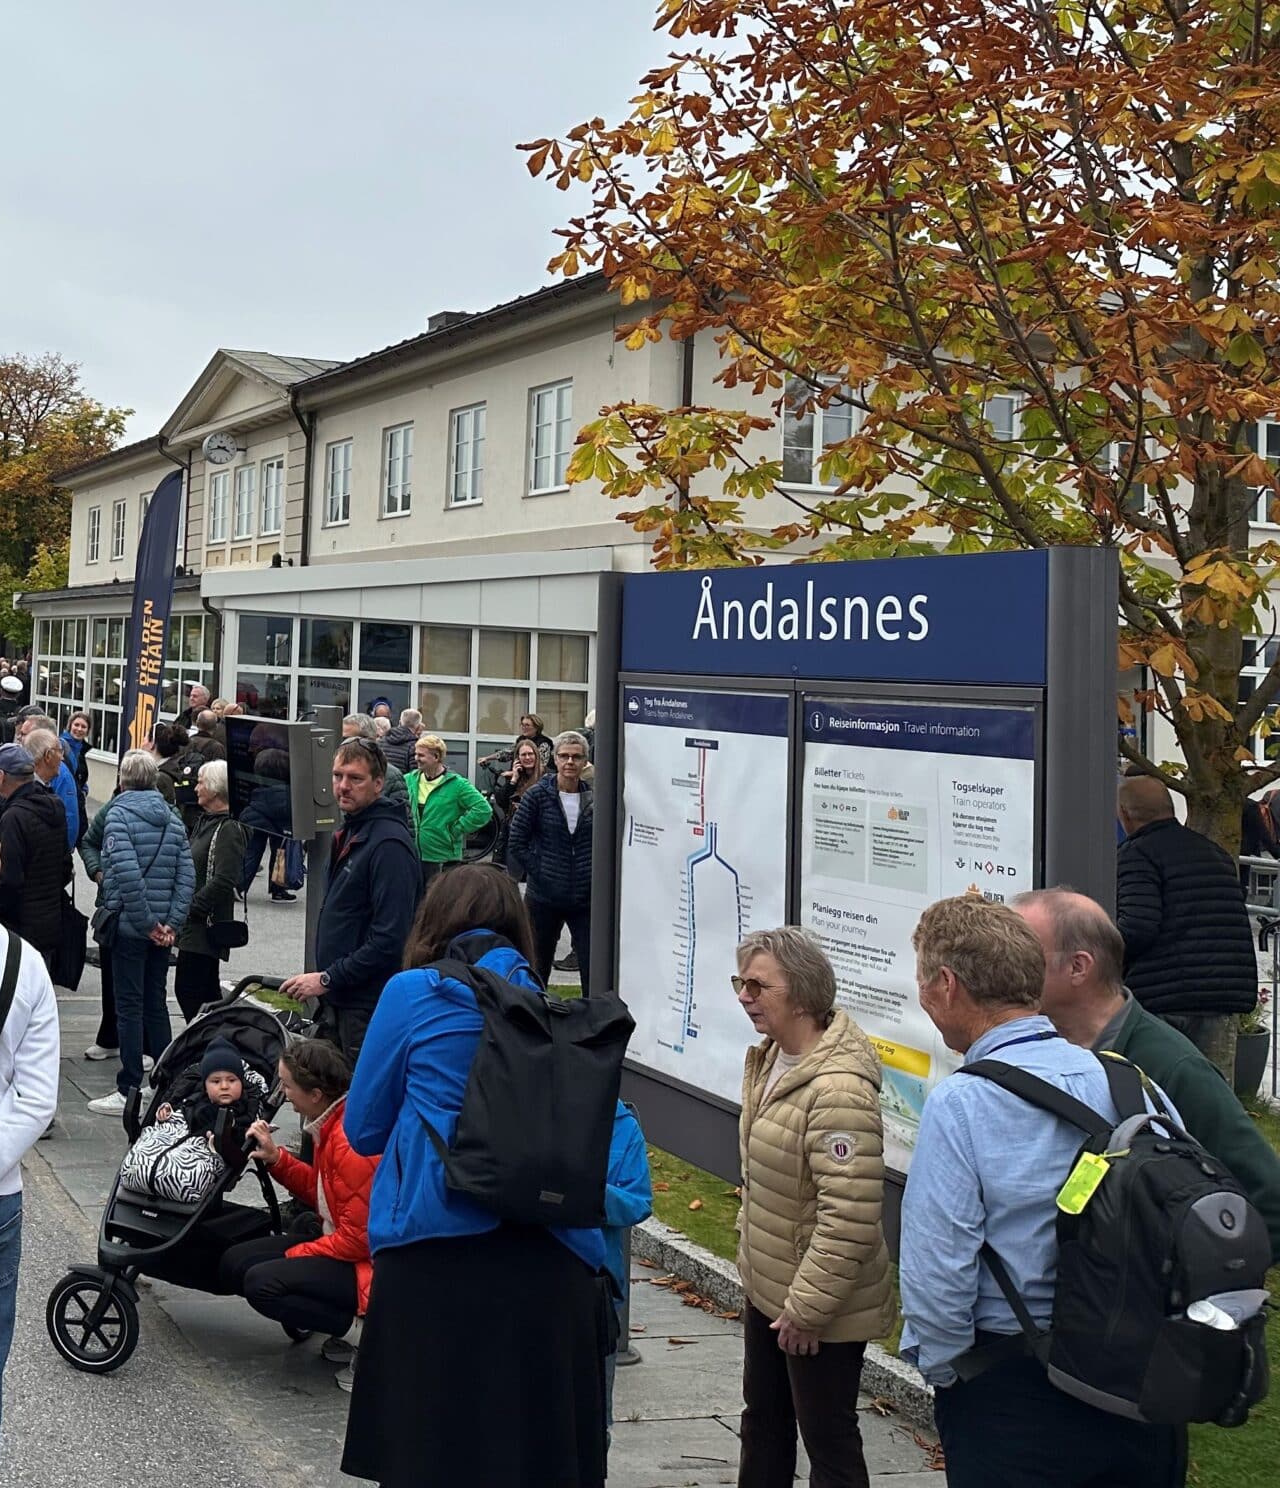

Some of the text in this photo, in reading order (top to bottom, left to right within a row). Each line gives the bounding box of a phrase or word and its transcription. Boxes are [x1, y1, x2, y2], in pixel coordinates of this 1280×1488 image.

[692, 575, 929, 641] Åndalsnes
[146, 618, 164, 687] TRAIN
[829, 716, 980, 737] Reiseinformasjon Travel information
[814, 767, 865, 781] Billetter Tickets
[952, 780, 1005, 797] Togselskaper
[952, 795, 1007, 811] Train operators
[974, 861, 1017, 877] NORD
[812, 902, 878, 925] Planlegg reisen din
[812, 915, 825, 926] Plan
[826, 920, 841, 930] your
[841, 923, 867, 938] journey
[884, 1045, 896, 1055] tog
